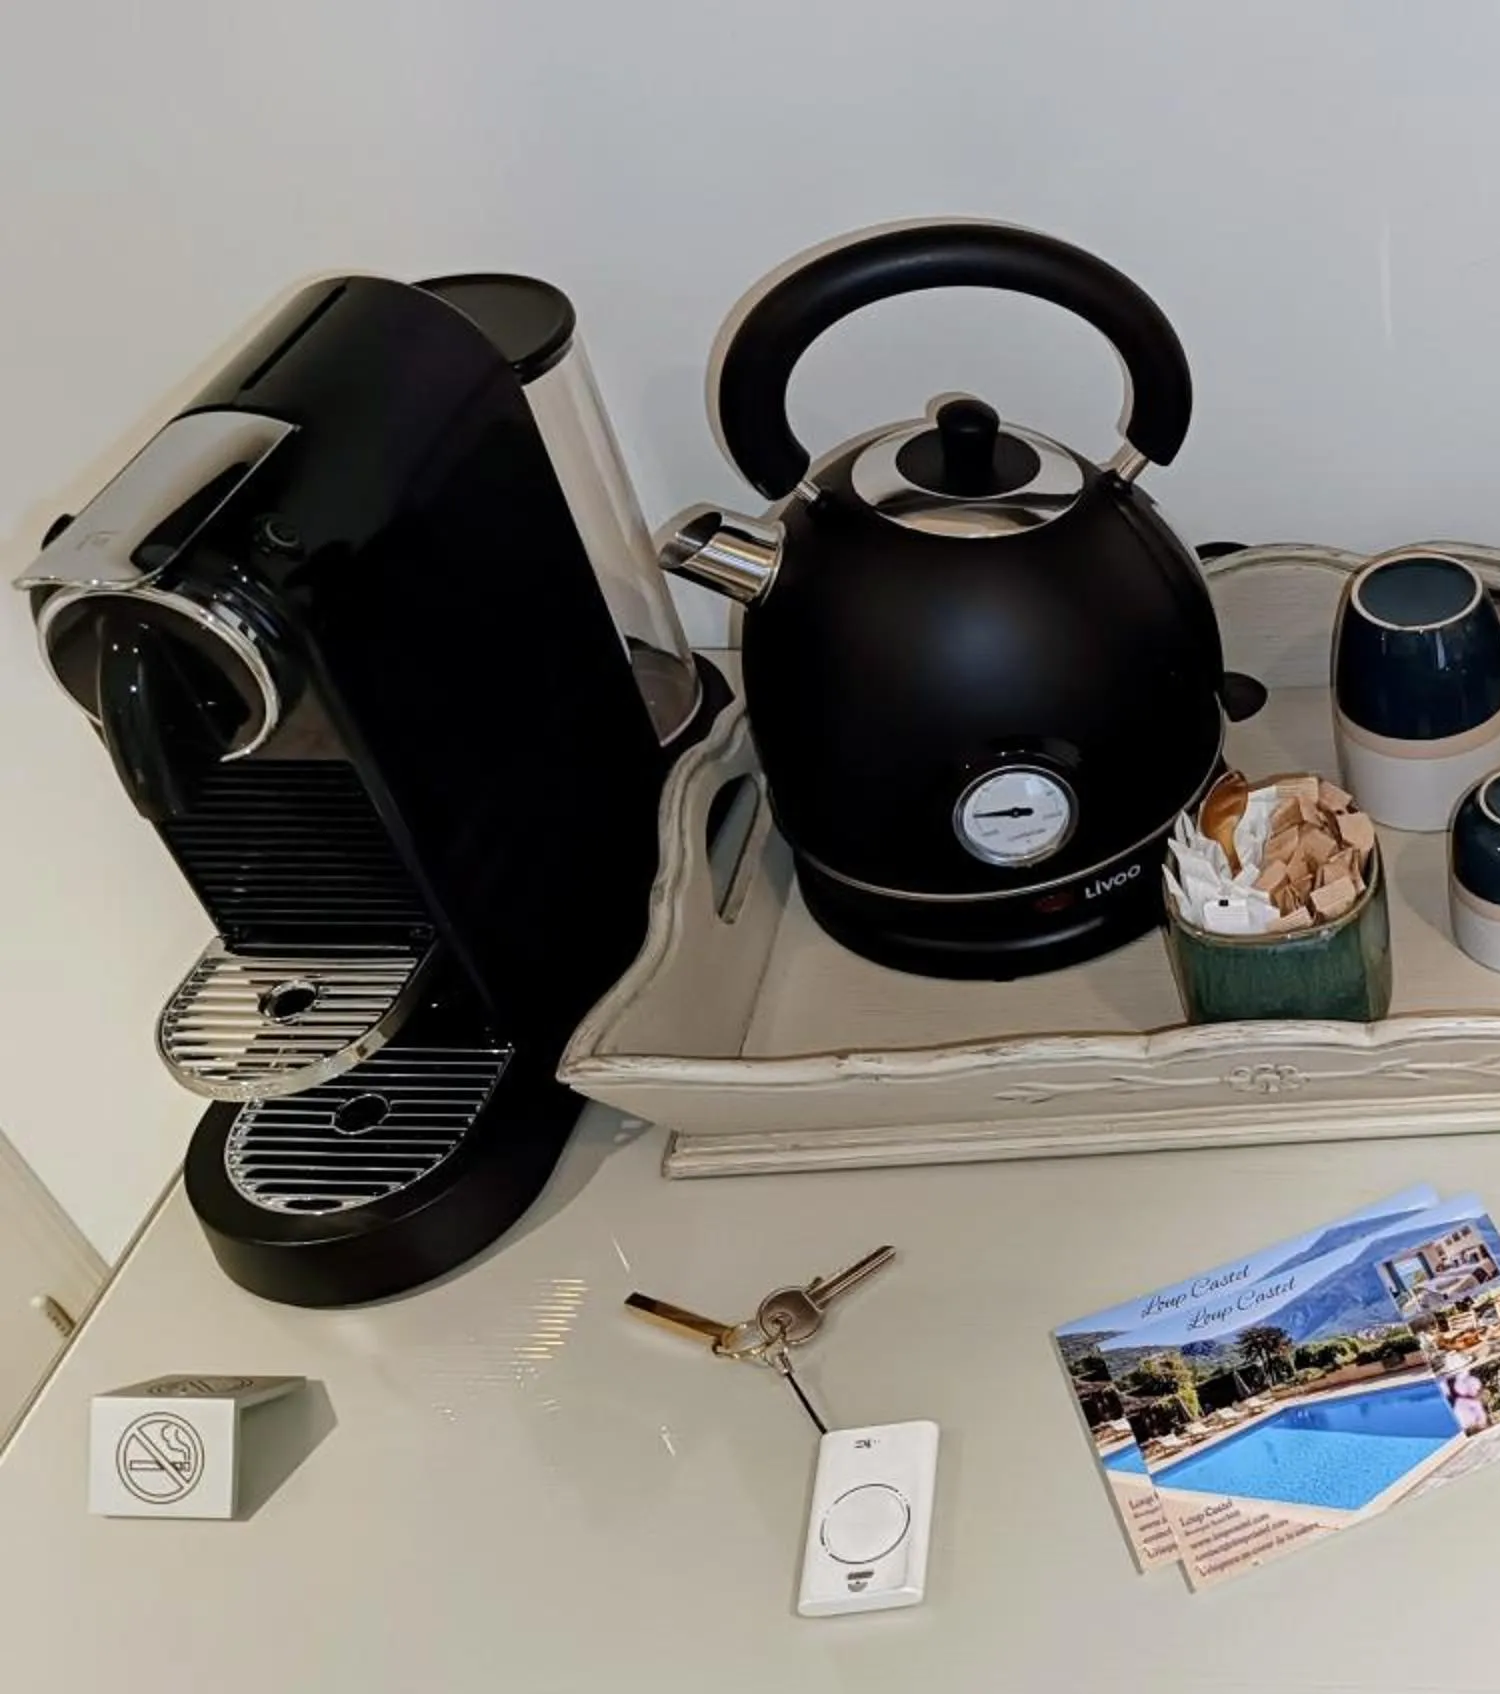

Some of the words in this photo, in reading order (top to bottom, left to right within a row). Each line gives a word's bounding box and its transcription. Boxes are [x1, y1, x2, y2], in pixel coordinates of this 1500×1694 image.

[1141, 1294, 1187, 1320] Loup
[1190, 1264, 1250, 1299] Castel
[1187, 1306, 1234, 1332] Loup
[1236, 1275, 1296, 1311] Castel
